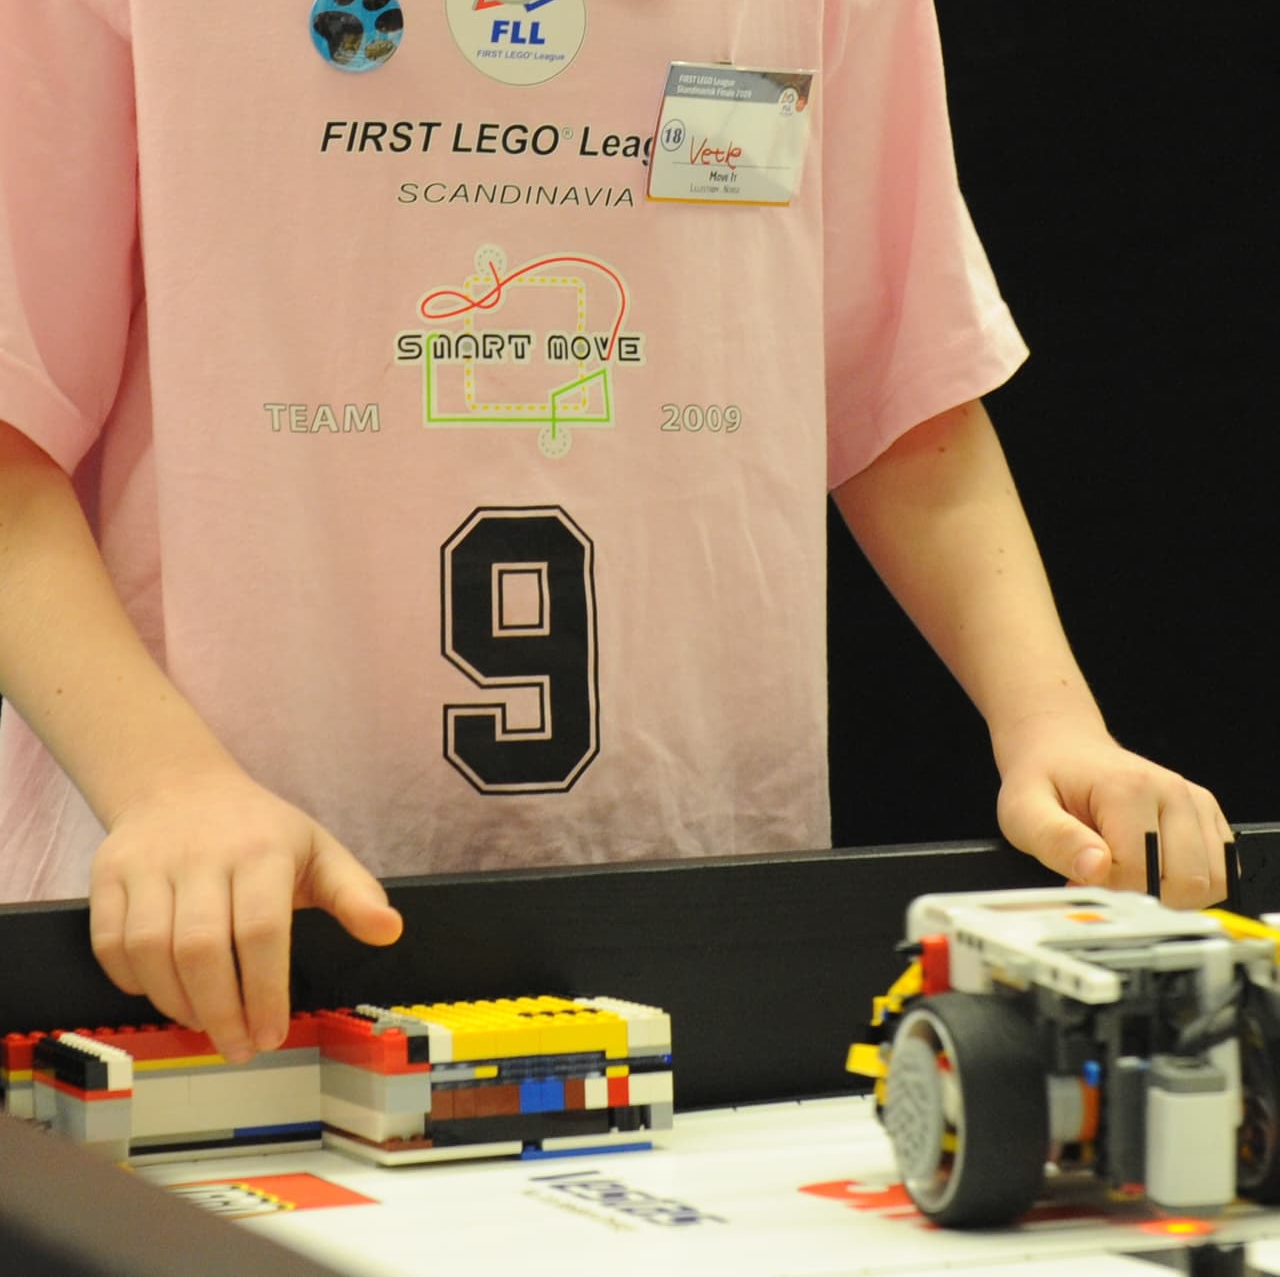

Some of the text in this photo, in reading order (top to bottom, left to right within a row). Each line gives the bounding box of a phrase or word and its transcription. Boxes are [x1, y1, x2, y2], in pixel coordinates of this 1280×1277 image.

[490, 19, 546, 45] FLL
[476, 49, 502, 59] FIRST
[533, 51, 565, 63] League
[320, 121, 442, 153] FIRST
[664, 128, 683, 144] 18
[397, 182, 635, 208] SCANDINAVIA
[396, 333, 642, 362] SMART MOVE
[263, 402, 382, 434] TEAM
[659, 403, 743, 433] 2009
[440, 504, 601, 796] 9
